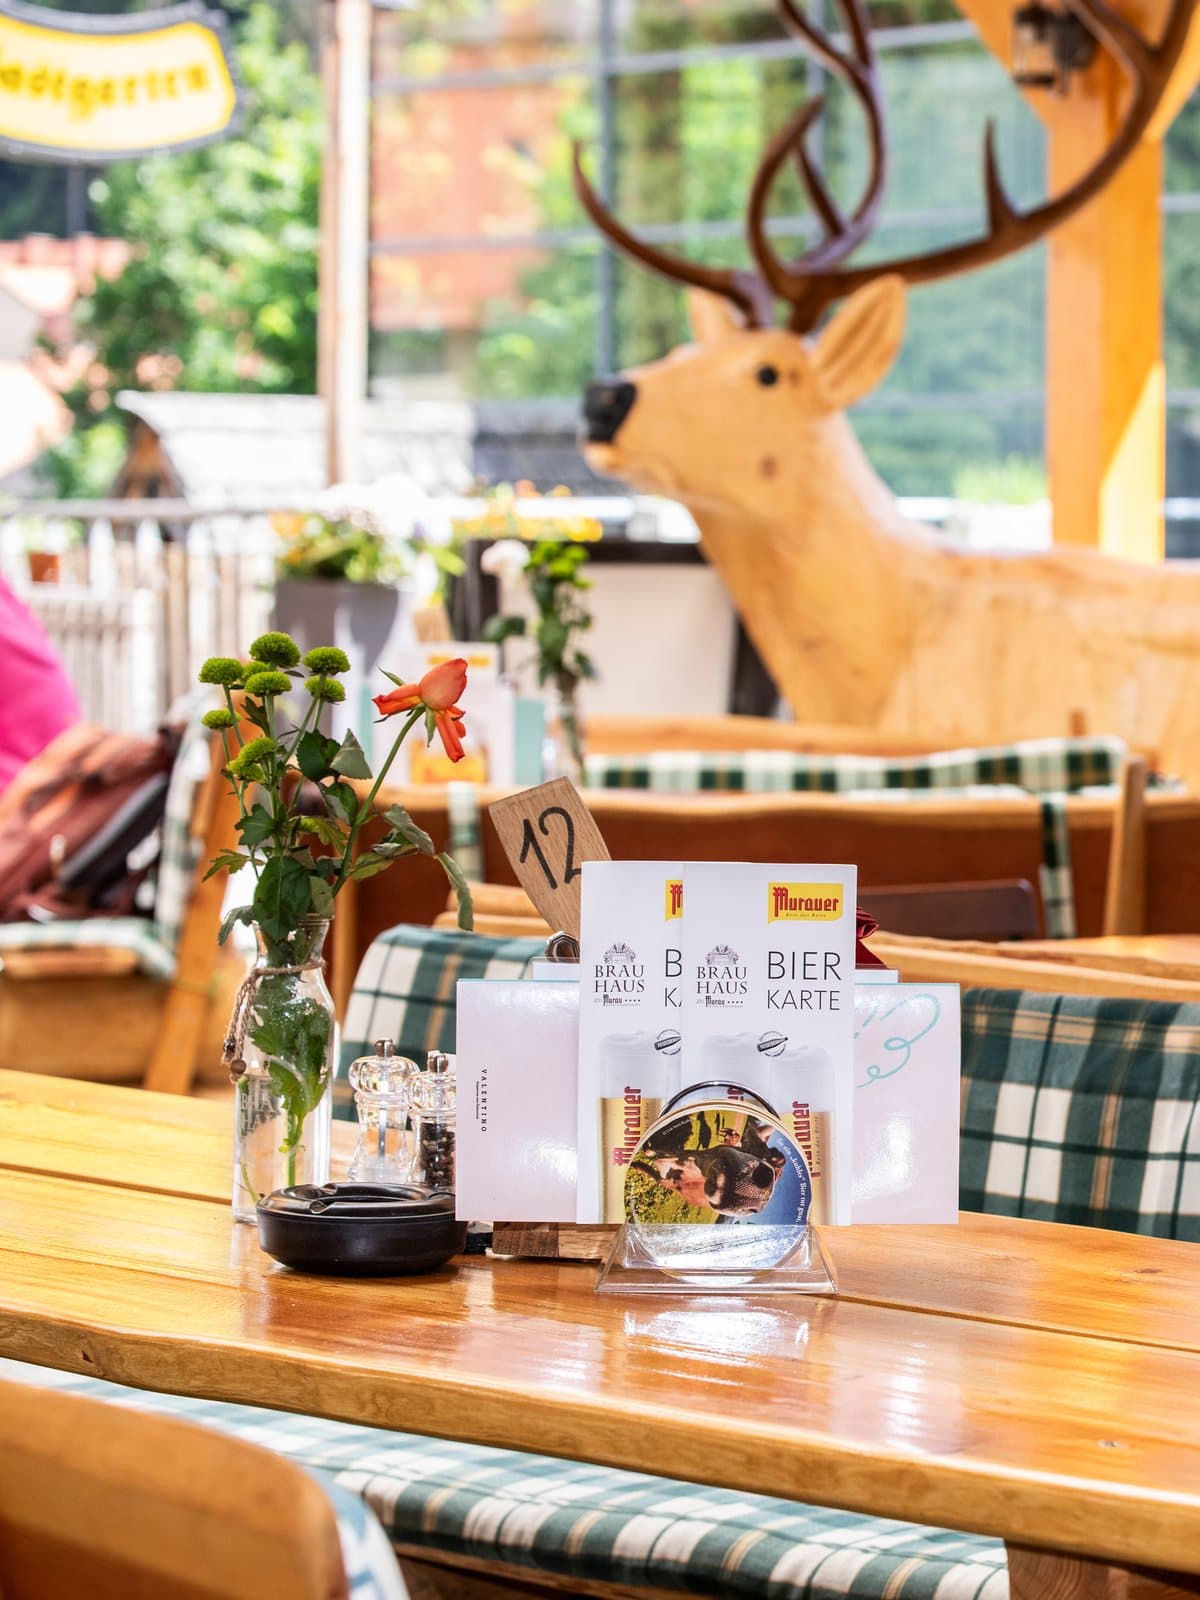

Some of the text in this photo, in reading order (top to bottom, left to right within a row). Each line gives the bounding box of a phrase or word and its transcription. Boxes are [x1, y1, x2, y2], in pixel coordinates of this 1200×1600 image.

[519, 806, 582, 889] 12
[772, 886, 839, 917] Murauer
[594, 964, 645, 978] BRAU
[696, 966, 748, 980] BRAU
[767, 951, 842, 981] BIER
[594, 979, 646, 993] HAUS
[696, 981, 748, 995] HAUS
[767, 989, 841, 1011] KARTE
